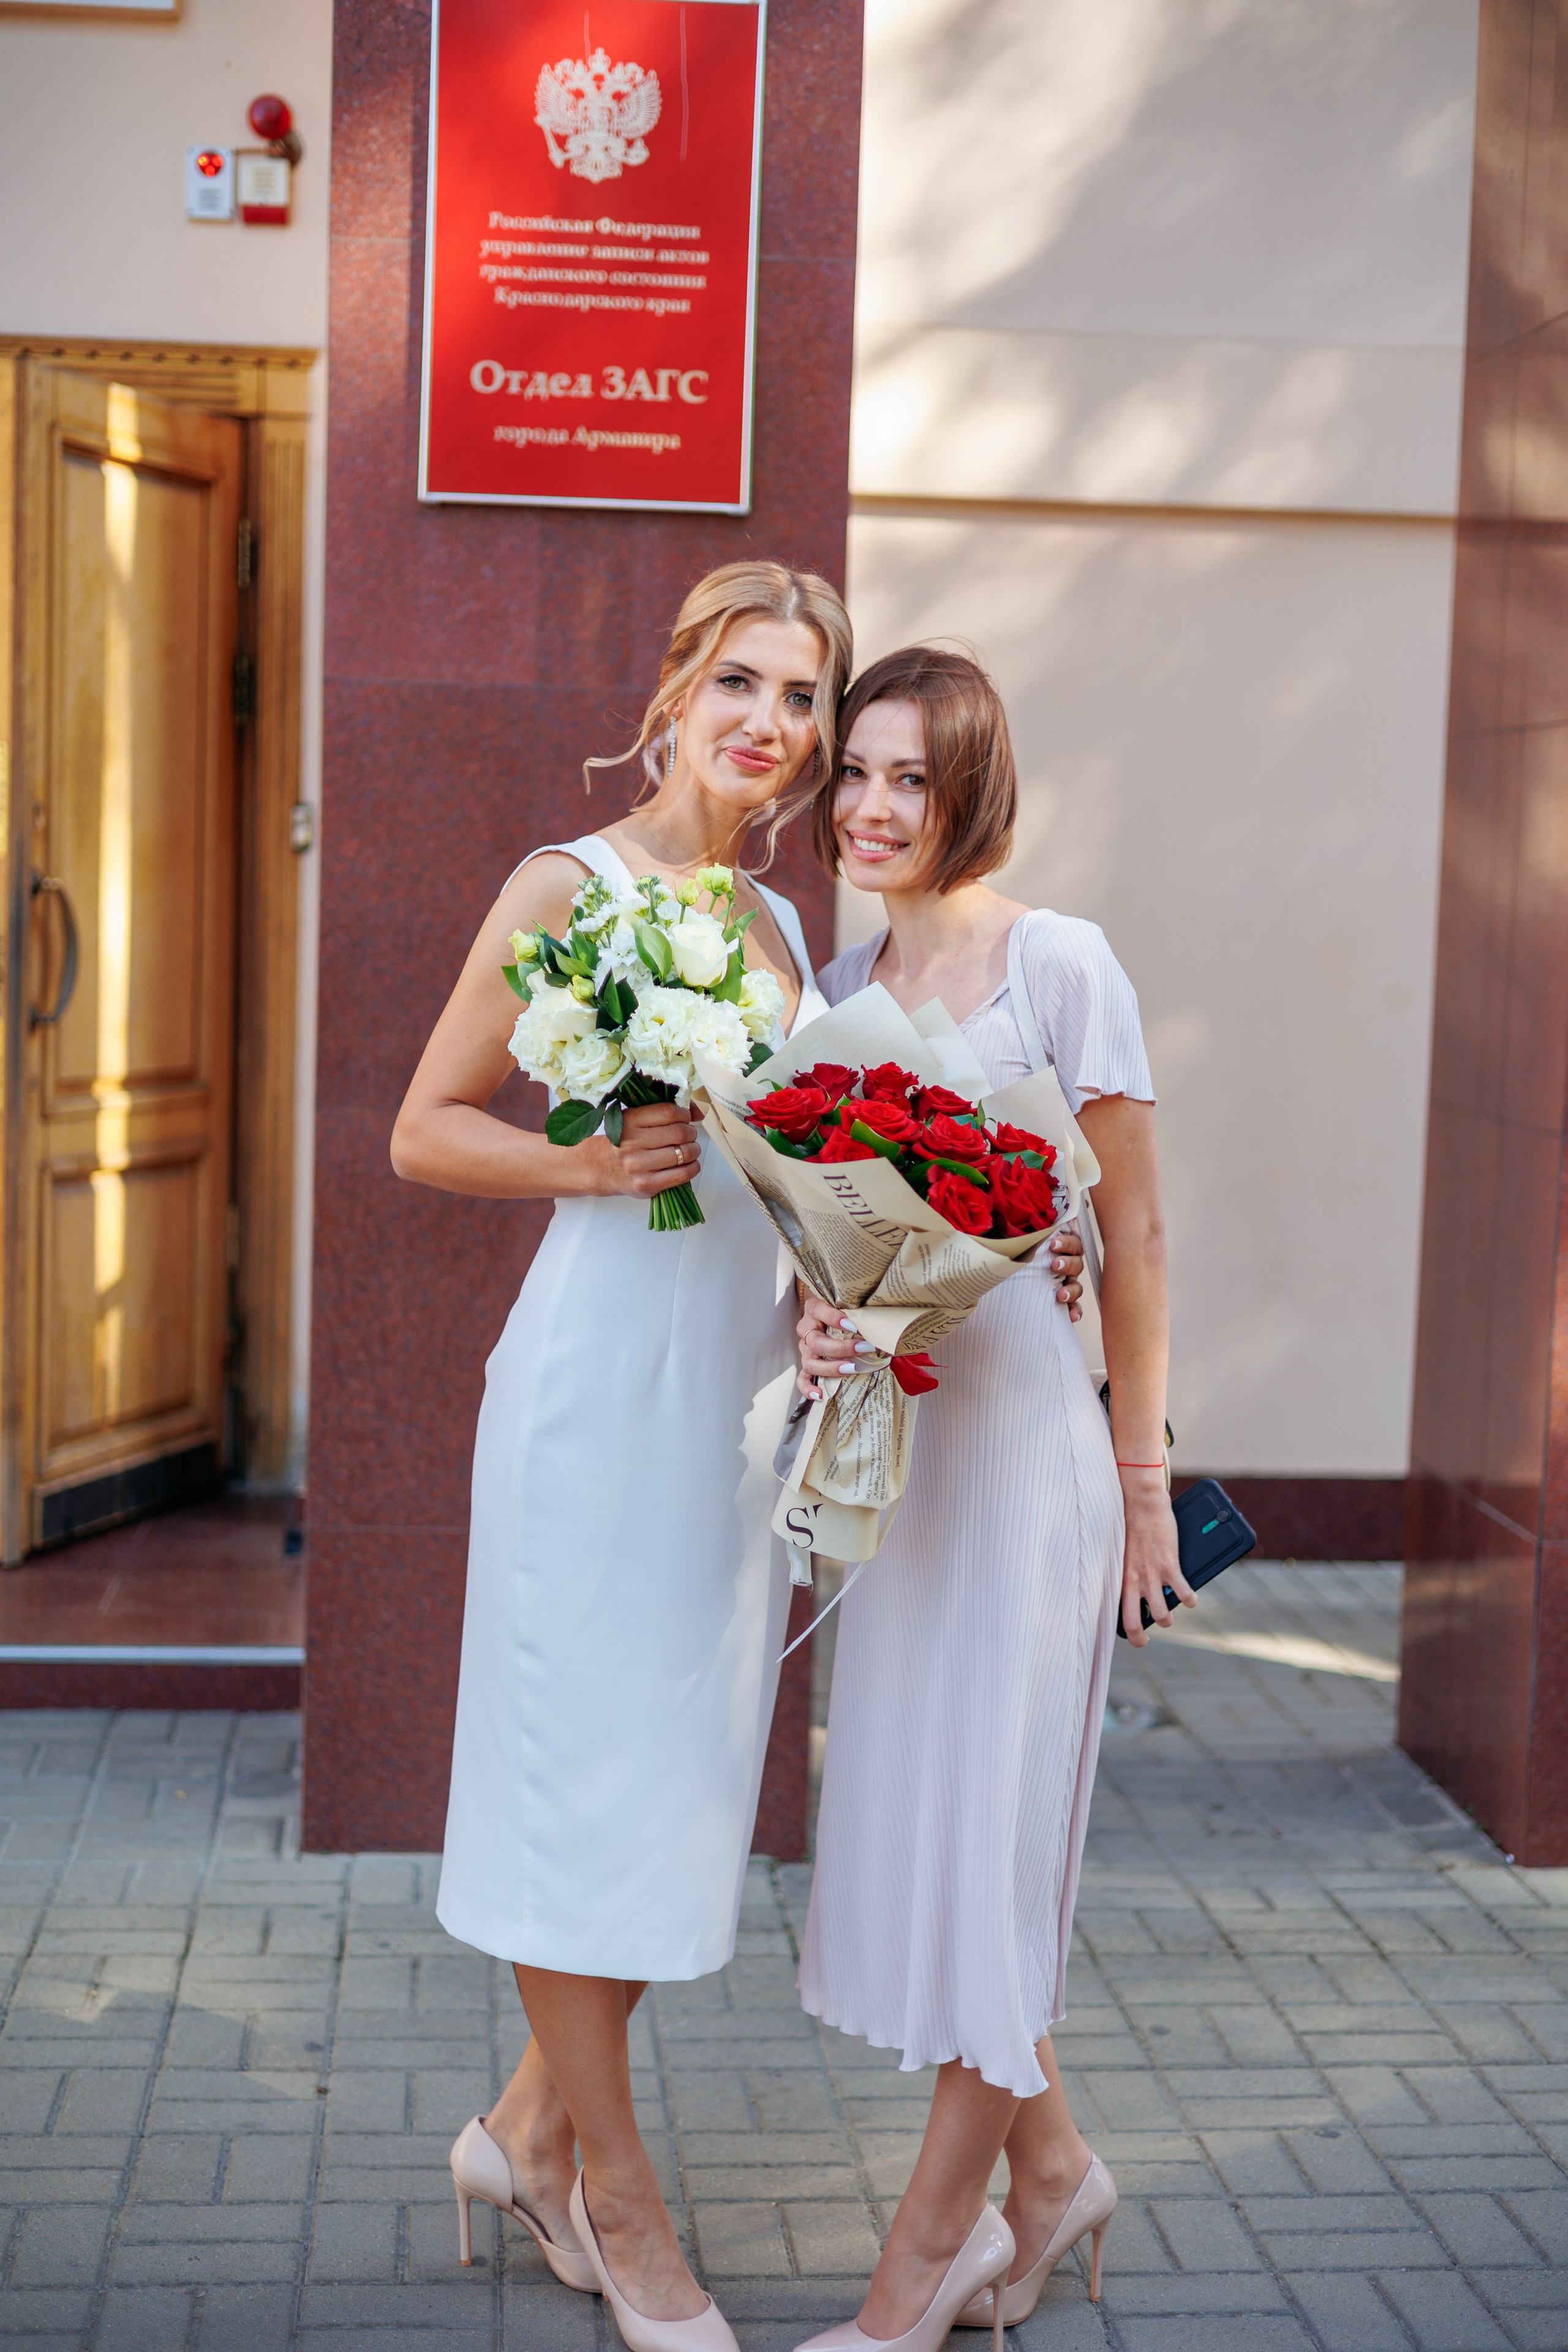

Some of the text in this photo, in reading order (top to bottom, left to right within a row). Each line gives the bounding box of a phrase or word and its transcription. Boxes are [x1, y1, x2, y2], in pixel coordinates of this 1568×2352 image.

[489, 210, 701, 241] Российская Федерации
[479, 239, 710, 265] управление записи актов
[480, 263, 707, 290] гражданского состояния
[494, 286, 692, 317] Краснодарского края
[469, 359, 709, 404] Отдел ЗАГС
[493, 424, 682, 455] города Армавира
